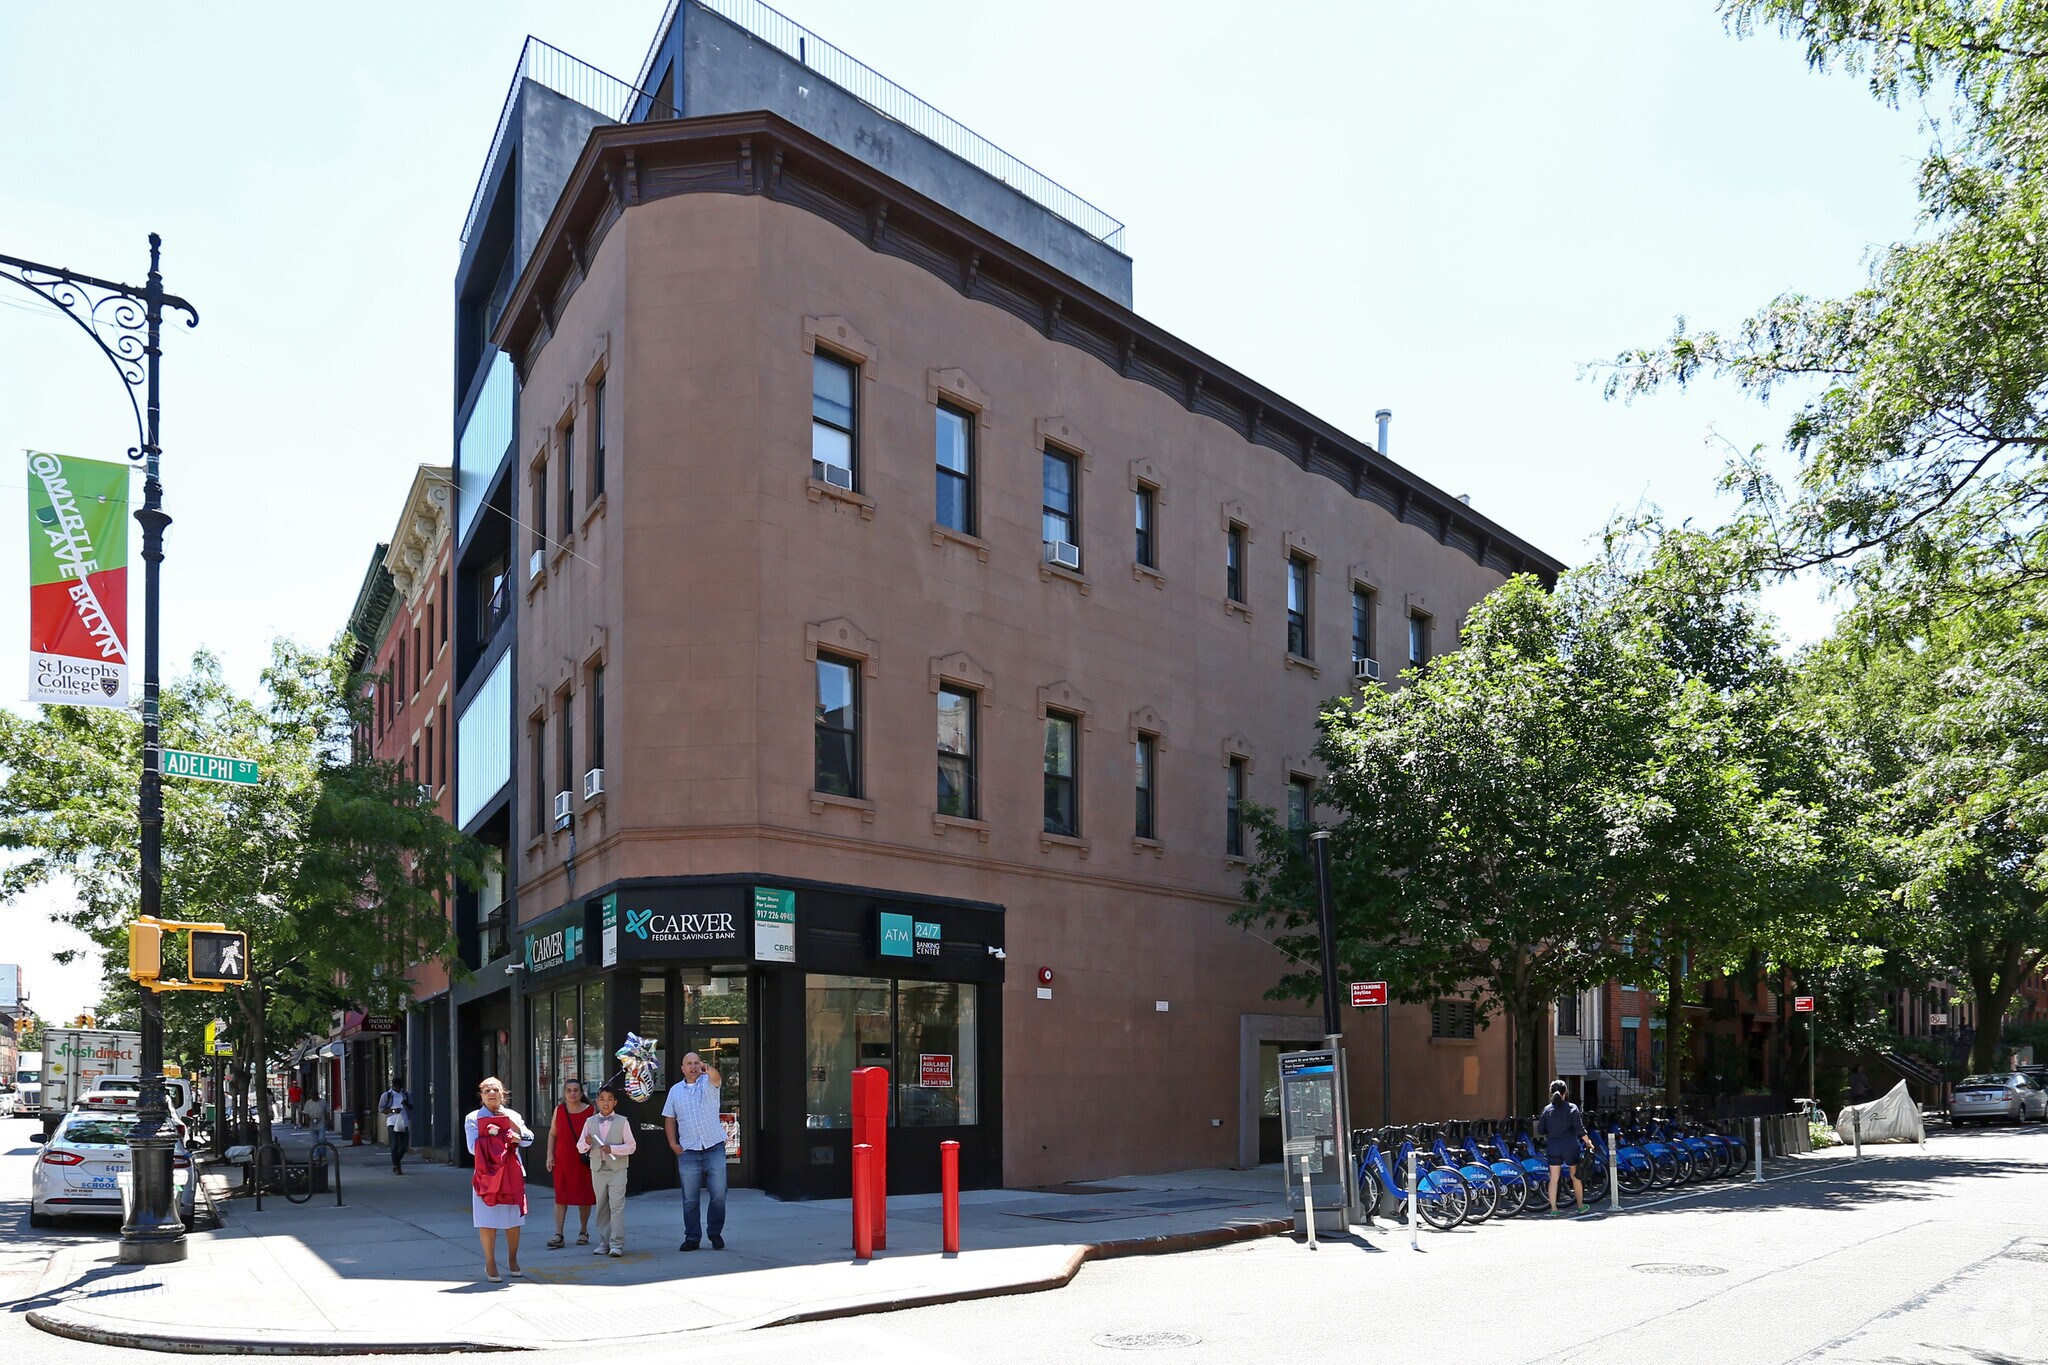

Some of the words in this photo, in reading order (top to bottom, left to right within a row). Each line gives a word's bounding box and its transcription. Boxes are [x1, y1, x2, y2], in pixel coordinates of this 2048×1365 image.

[68, 584, 120, 658] BKLYN
[56, 660, 119, 680] Joseph's
[38, 673, 99, 694] College
[167, 753, 233, 779] ADELPHI
[238, 763, 253, 774] ST
[756, 910, 768, 918] 917
[768, 910, 779, 920] 226
[649, 913, 736, 934] CARVER
[916, 924, 939, 938] 24/7
[885, 928, 908, 942] ATM
[532, 932, 563, 963] CARVER
[774, 944, 794, 952] CBRE
[916, 941, 940, 950] BANKING
[916, 948, 940, 956] CENTER
[544, 960, 554, 970] SAVINGS
[60, 1042, 132, 1060] freshdirect
